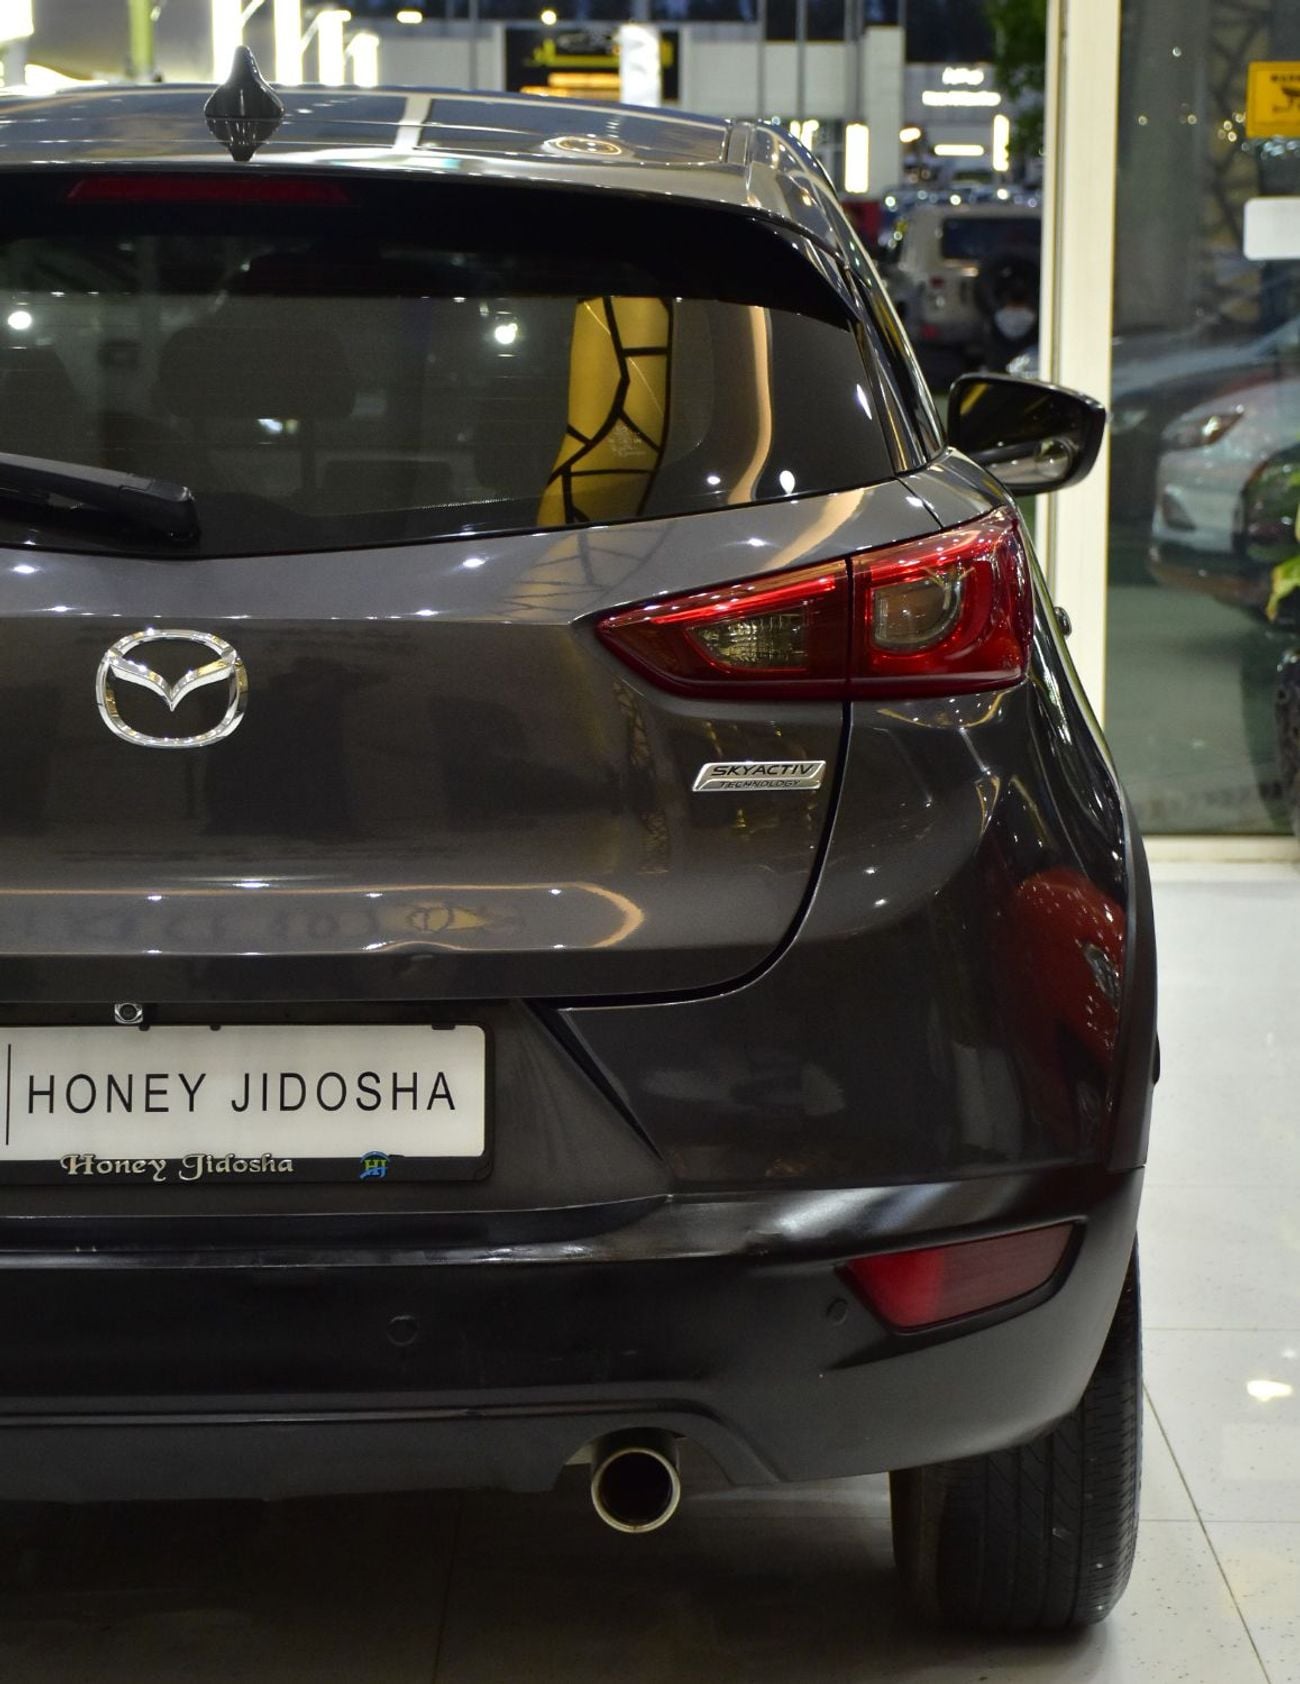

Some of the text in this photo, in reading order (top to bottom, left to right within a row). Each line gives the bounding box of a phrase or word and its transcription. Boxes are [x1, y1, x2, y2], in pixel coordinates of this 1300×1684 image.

[711, 764, 814, 776] SKYACTIV
[719, 780, 801, 789] TECHNOLOGY
[27, 1071, 456, 1114] HONEY JIDOSHA
[60, 1153, 294, 1182] Honey Jidosha
